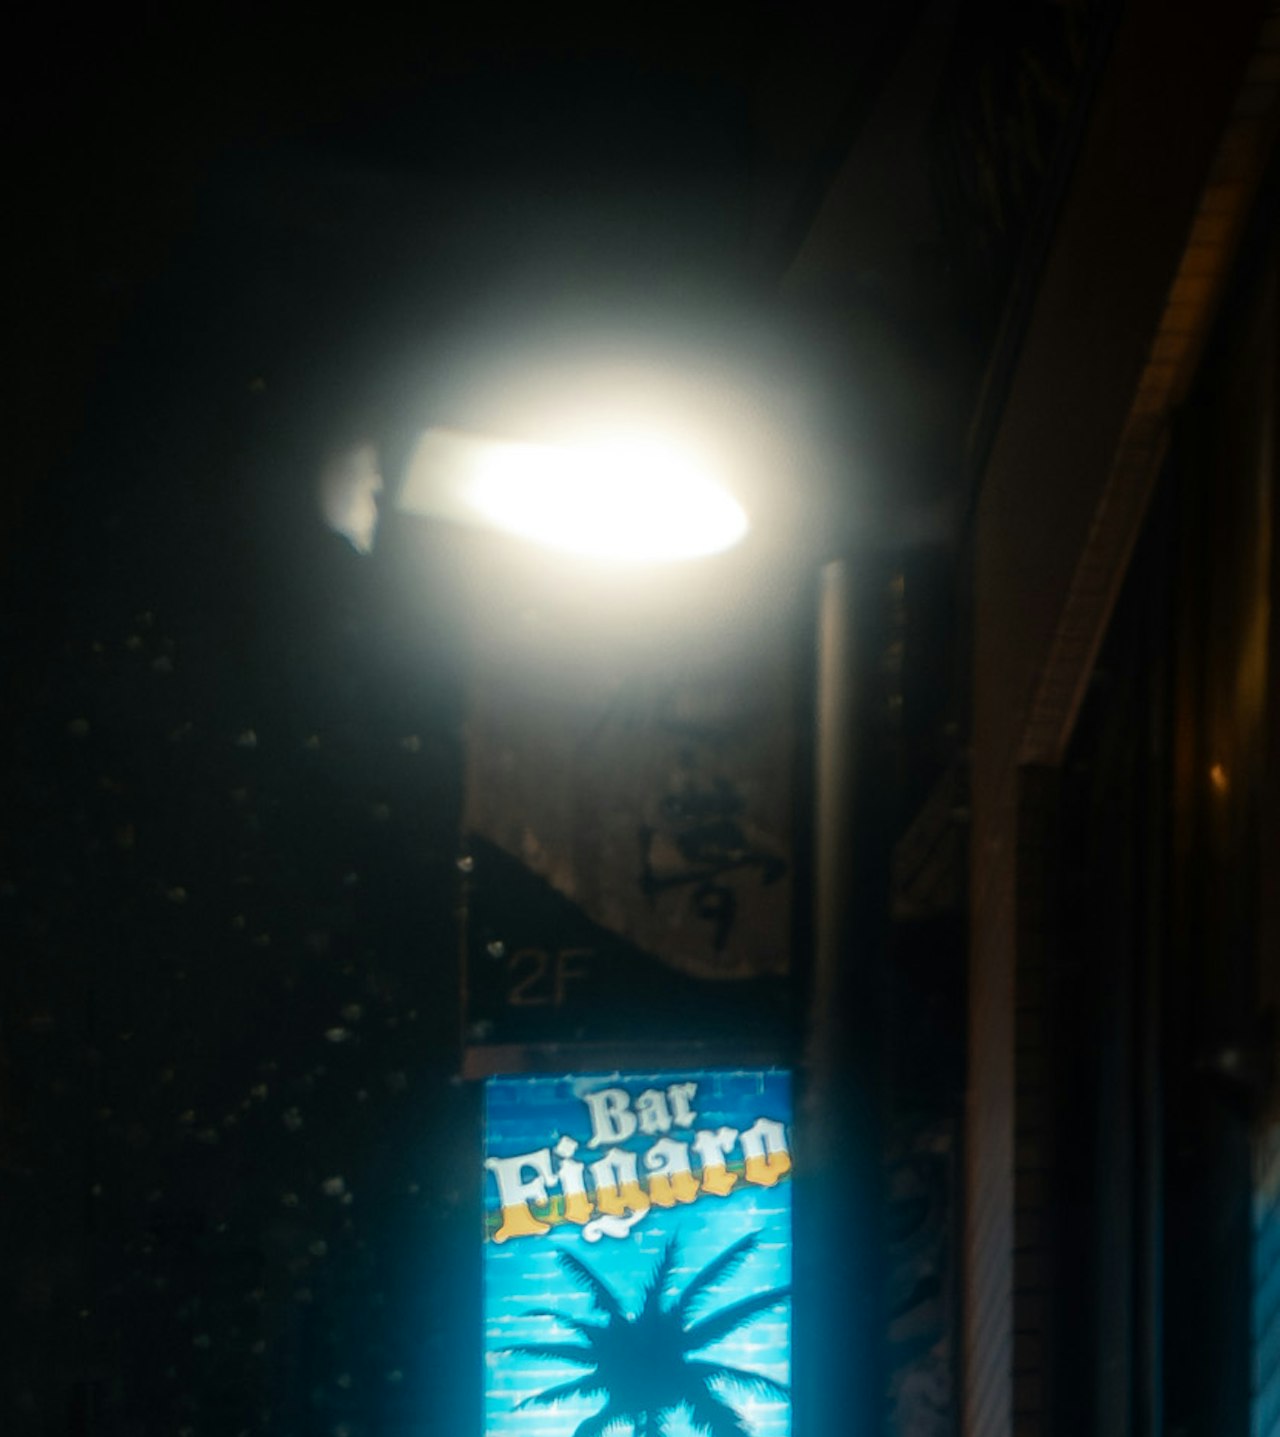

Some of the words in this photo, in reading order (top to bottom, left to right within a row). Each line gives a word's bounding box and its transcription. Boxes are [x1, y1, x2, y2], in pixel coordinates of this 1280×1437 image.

[506, 944, 596, 1008] 2F
[584, 1082, 698, 1148] Bar
[484, 1117, 792, 1244] Figaro
